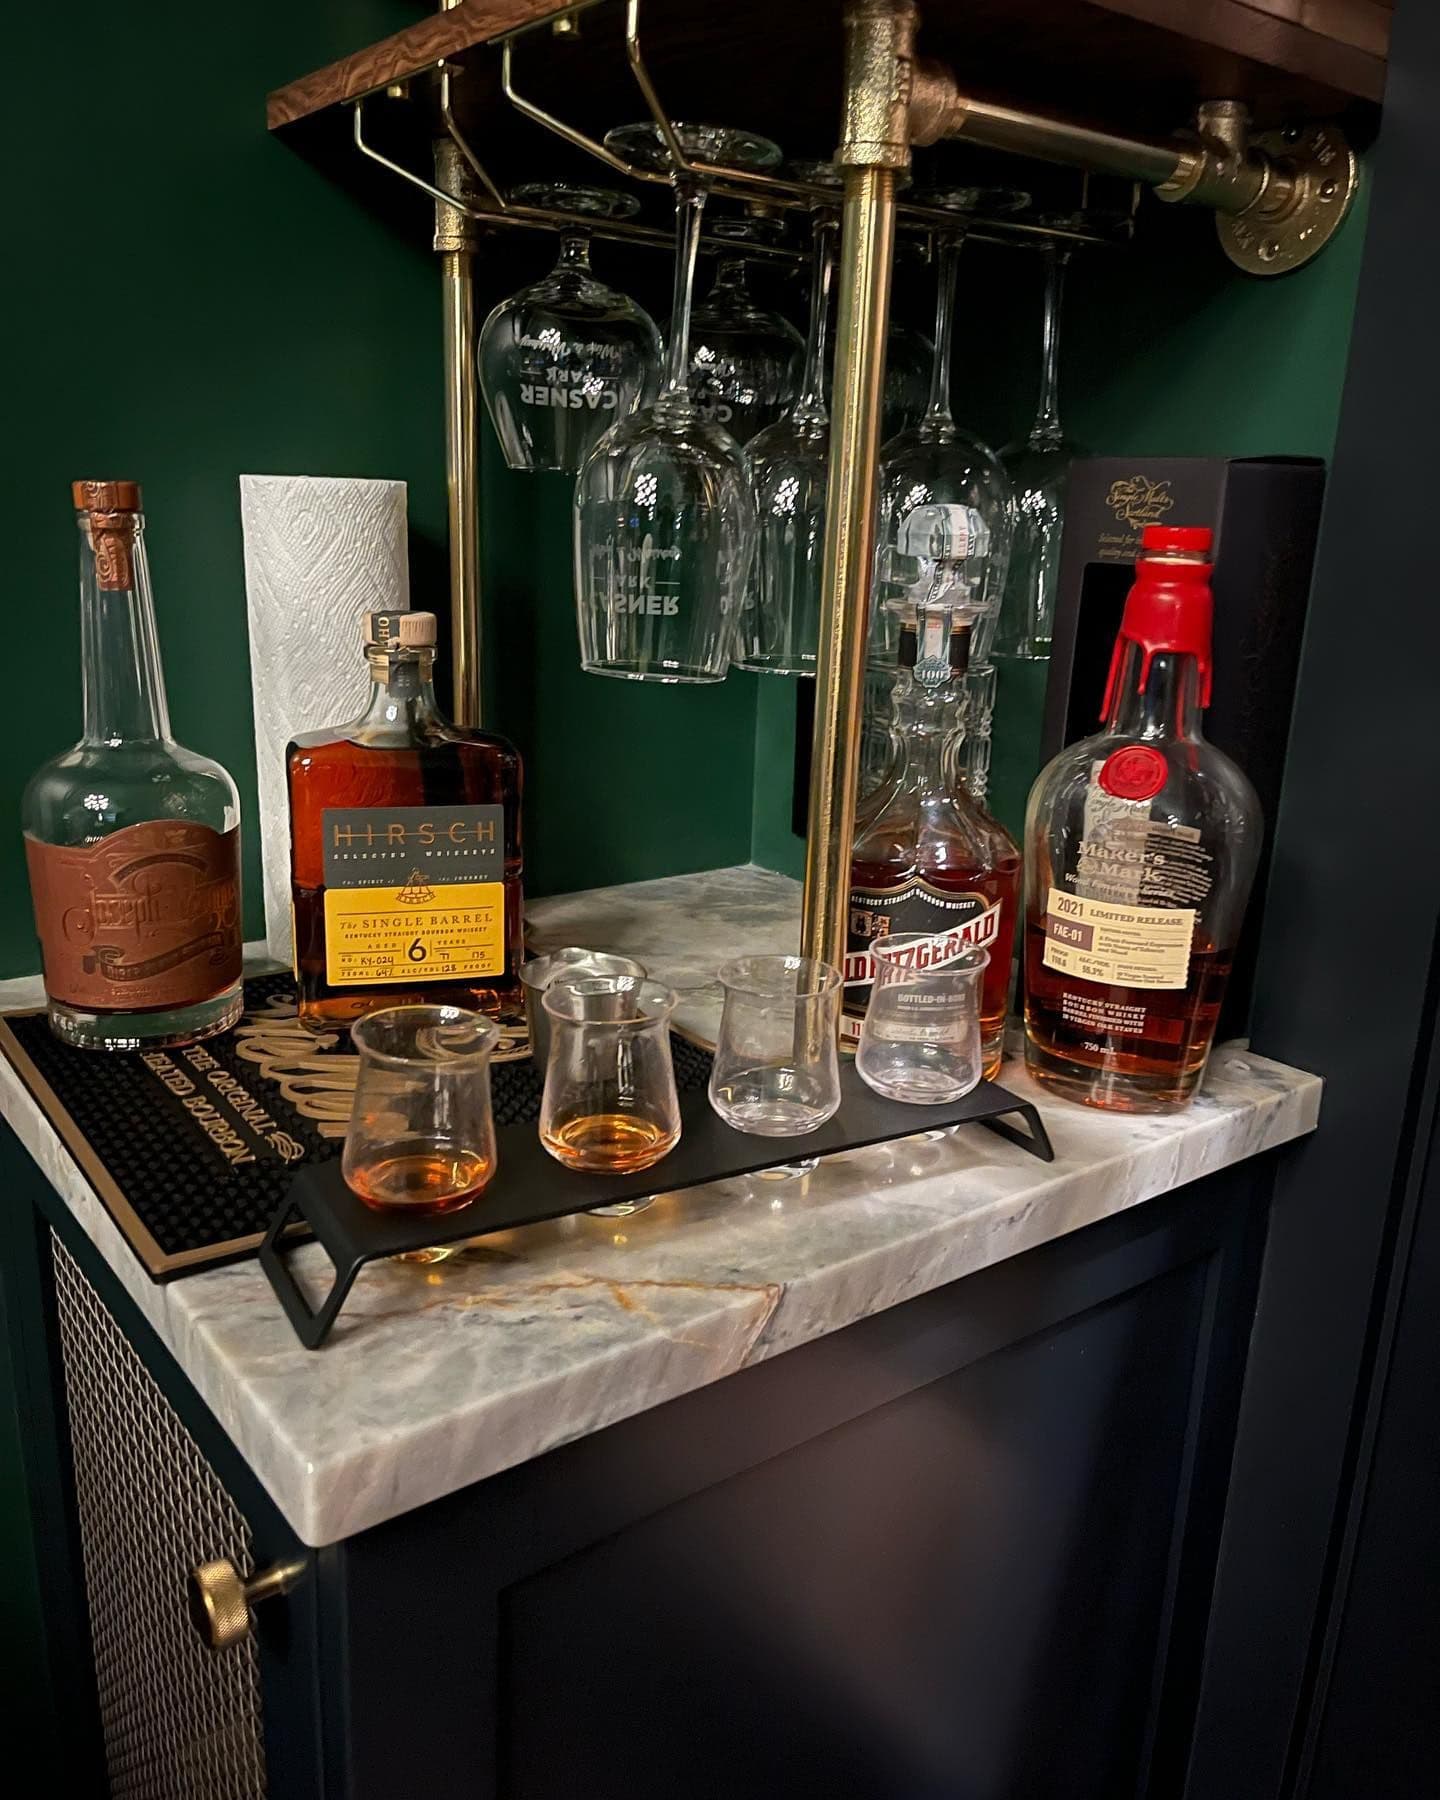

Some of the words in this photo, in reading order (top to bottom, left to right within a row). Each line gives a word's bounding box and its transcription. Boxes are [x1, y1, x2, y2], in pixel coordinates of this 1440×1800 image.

[545, 366, 593, 384] PARK
[520, 384, 618, 410] CASNER
[333, 820, 494, 847] HIRSCH
[333, 851, 406, 861] SELECTED
[425, 848, 496, 858] WHISKEYS
[1077, 841, 1167, 867] Maker's
[1101, 861, 1163, 882] Mark
[362, 916, 424, 929] SINGLE
[430, 913, 493, 926] BARREL
[1057, 896, 1084, 918] 2021
[1089, 908, 1135, 923] LIMITED
[1136, 916, 1184, 926] RELEASE
[345, 931, 382, 940] KENTUCKY
[384, 929, 420, 938] STRAIGHT
[421, 928, 454, 936] BOURBON
[456, 926, 488, 934] WHISKEY
[1053, 923, 1083, 942] FAE-01
[407, 937, 427, 962] 6
[1062, 992, 1104, 1007] KENTUCKY
[1062, 999, 1105, 1015] BOURBON
[1107, 1010, 1146, 1020] WHISKY
[1084, 1041, 1099, 1052] 750
[182, 1045, 211, 1073] THE
[207, 1068, 278, 1136] ORIGINAL
[181, 1094, 257, 1166] BOURBON
